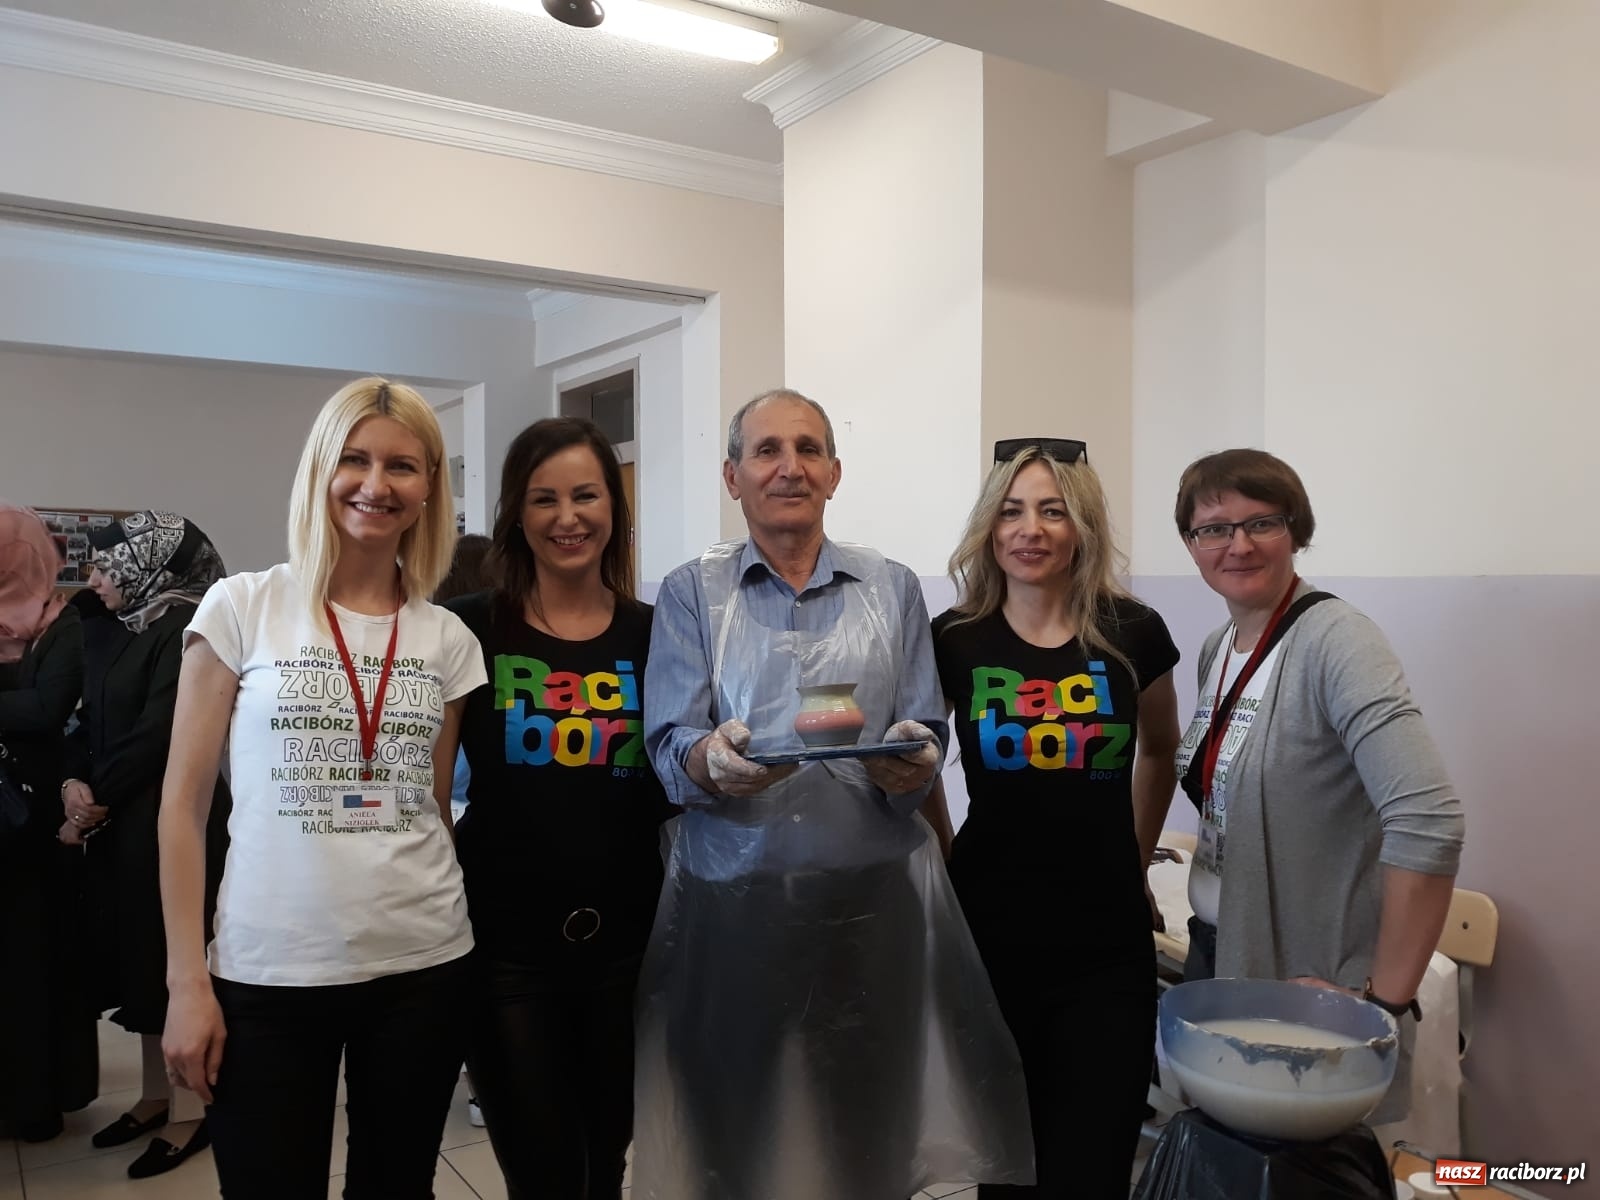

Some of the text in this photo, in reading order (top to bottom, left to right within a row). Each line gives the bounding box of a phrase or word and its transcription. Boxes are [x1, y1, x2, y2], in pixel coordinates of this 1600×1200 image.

[274, 659, 334, 670] RACIBÓRZ
[301, 645, 425, 671] RACIBZ RACBÓRZ
[494, 654, 640, 711] Raci
[970, 661, 1113, 721] Raci
[278, 704, 322, 712] RACIBÓRZ
[384, 709, 424, 720] RACIBÓRZ
[271, 715, 433, 739] RACIBÓRZ CIBÓRZ
[271, 765, 323, 782] RACIBÓRZ
